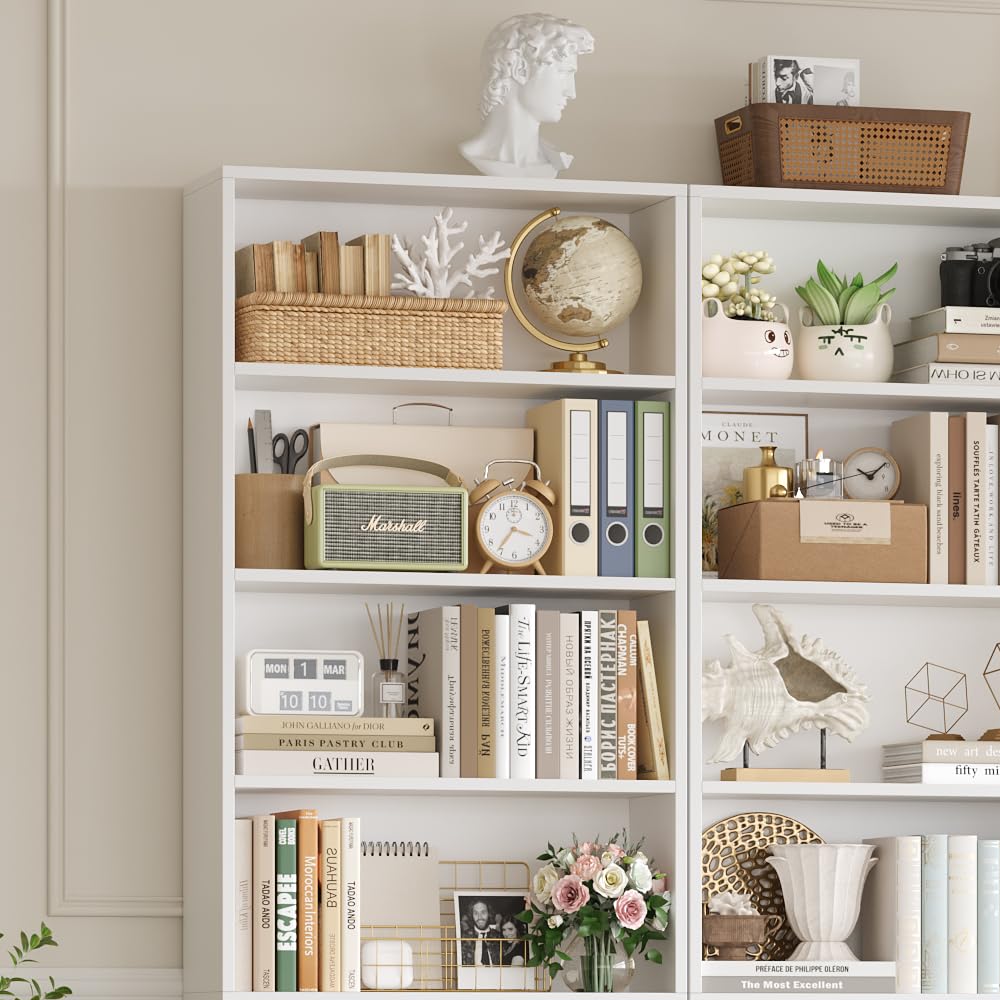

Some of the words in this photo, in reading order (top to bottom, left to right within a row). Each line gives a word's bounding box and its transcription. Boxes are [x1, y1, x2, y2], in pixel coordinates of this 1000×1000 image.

[702, 430, 778, 443] MONET
[935, 453, 943, 487] exploring
[973, 440, 981, 477] SOUFFLÉS
[510, 499, 519, 508] 12
[952, 491, 962, 520] lines.
[361, 514, 427, 532] Marshall
[973, 528, 981, 563] GÂTEAUX
[584, 621, 592, 644] ПРЯТКИ
[565, 635, 575, 676] НОВЫЙ
[584, 646, 591, 654] НА
[617, 624, 627, 676] CHAPMAN
[265, 663, 287, 674] MON
[300, 661, 307, 677] 1
[323, 665, 345, 675] MAR
[584, 657, 592, 679] ОСЕВОЙ
[600, 618, 616, 713] ПАСТЕРНАК
[281, 694, 298, 709] 10
[310, 694, 327, 709] 10
[565, 680, 573, 715] ОБРАЗ
[282, 721, 305, 729] JOHN
[306, 722, 350, 730] GALLIANO
[351, 722, 361, 731] for
[627, 723, 636, 746] BOOK
[279, 739, 315, 747] PARIS
[319, 740, 366, 748] PASTRY
[371, 740, 404, 749] CLUB
[565, 718, 573, 759] ЖИЗНИ
[600, 719, 616, 772] БОРИС
[617, 735, 626, 760] TUTS+
[627, 747, 636, 772] COVER
[936, 748, 958, 757] new
[964, 747, 978, 757] art
[313, 757, 375, 771] GATHER
[955, 765, 978, 778] fifty
[262, 880, 270, 906] TADAO
[304, 856, 316, 912] Moroccan
[347, 881, 356, 907] TADAO
[262, 908, 270, 929] ANDO
[277, 873, 297, 951] ESCAPEE
[347, 909, 356, 930] ANDO
[304, 912, 316, 956] Interiors
[785, 965, 793, 973] DE
[795, 965, 823, 973] PHILIPPE
[741, 981, 760, 989] The
[763, 981, 790, 989] Most
[793, 981, 843, 989] Excellent
